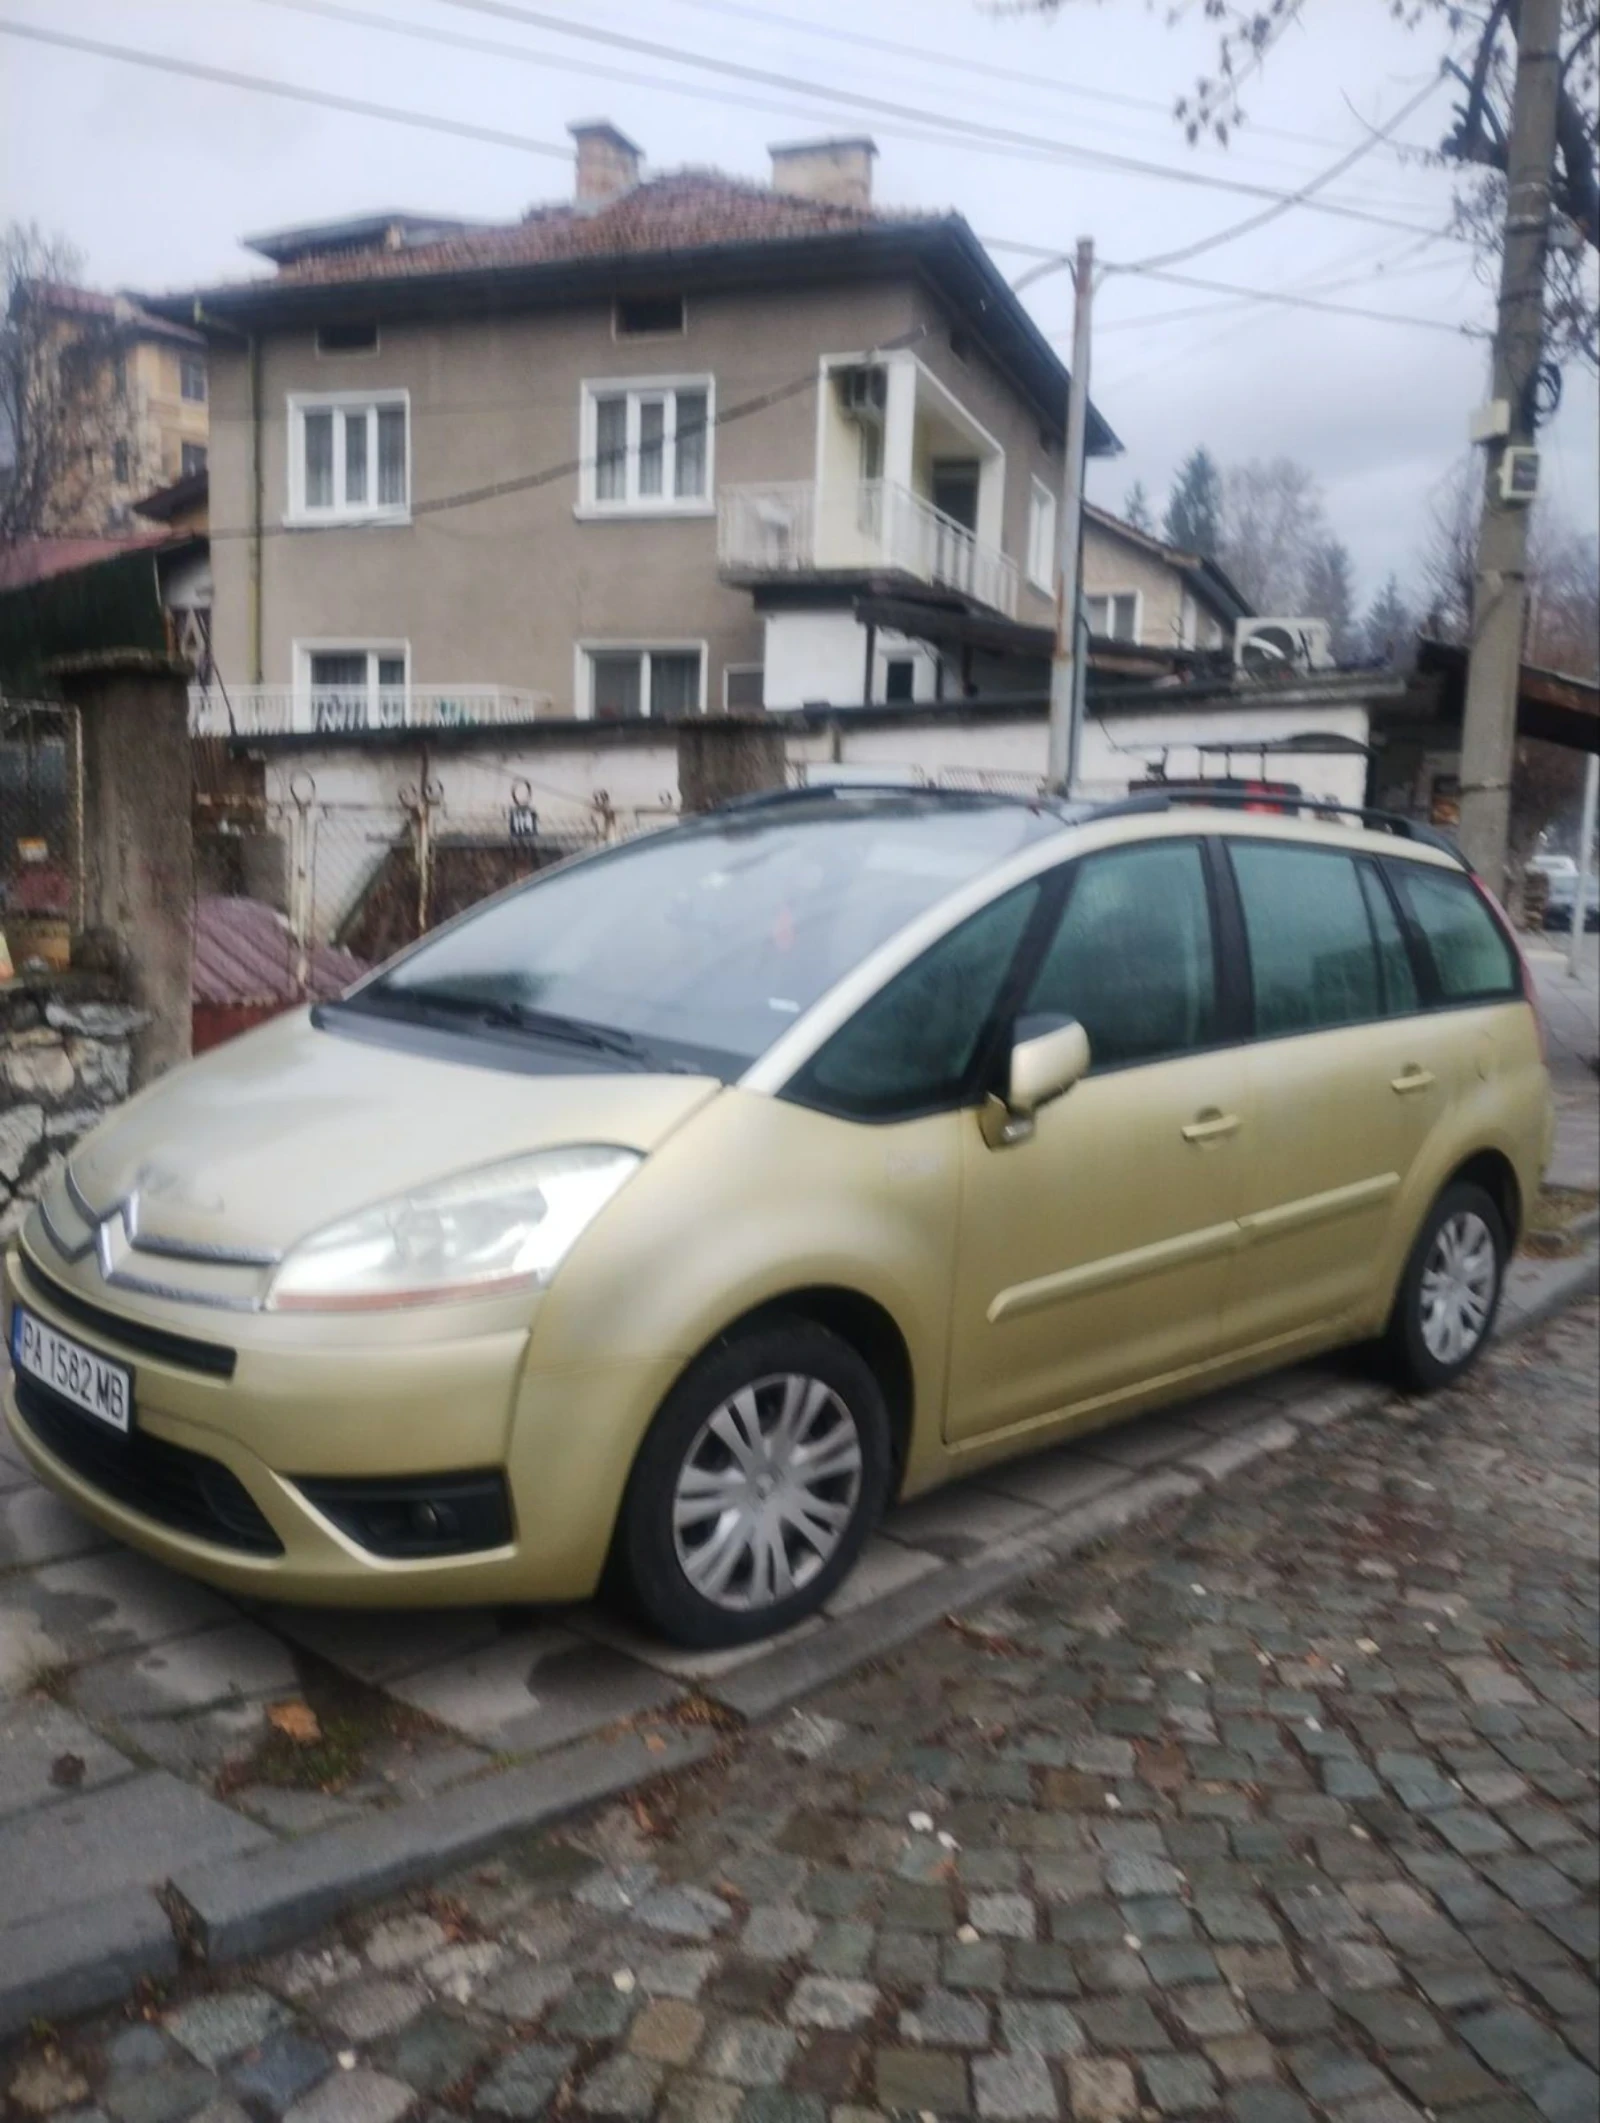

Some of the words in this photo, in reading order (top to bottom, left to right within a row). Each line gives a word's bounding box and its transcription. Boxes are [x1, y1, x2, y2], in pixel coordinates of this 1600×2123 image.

[24, 1320, 43, 1374] PA
[50, 1337, 92, 1402] 1582
[96, 1363, 124, 1421] MB
